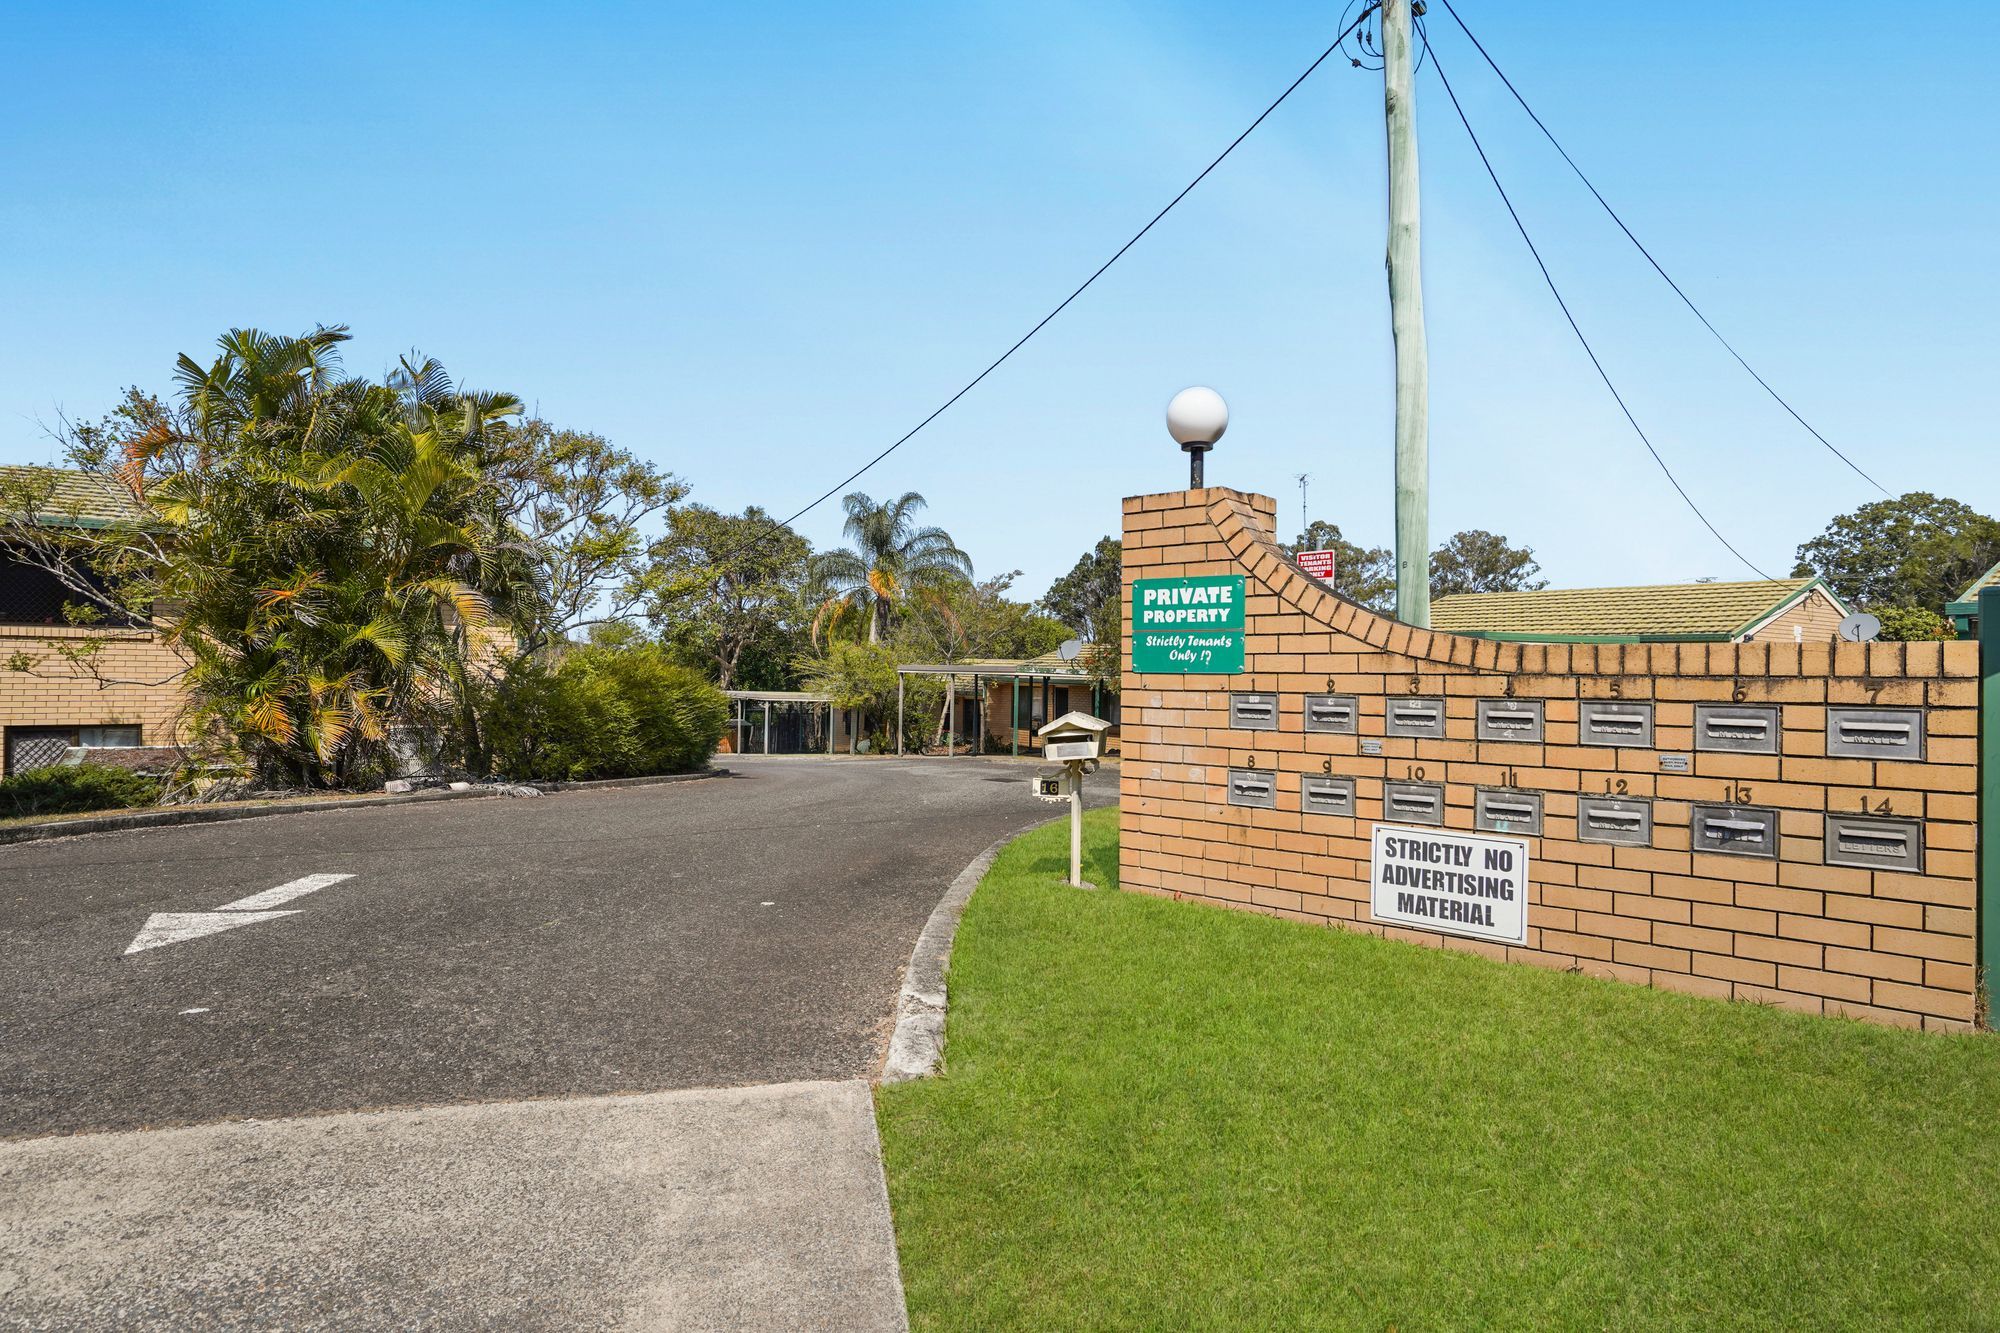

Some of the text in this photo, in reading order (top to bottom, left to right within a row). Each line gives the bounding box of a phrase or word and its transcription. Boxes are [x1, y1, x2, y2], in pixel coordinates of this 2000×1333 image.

[1300, 559, 1332, 567] TENANTS
[1143, 586, 1233, 605] PRIVATE
[1143, 608, 1230, 623] PROPERTY
[1146, 635, 1232, 648] Strictly Tenants
[1169, 649, 1197, 663] Only
[1251, 678, 1255, 691] 1
[1326, 679, 1335, 694] 2
[1409, 677, 1420, 695] 3
[1503, 680, 1516, 698] 4
[1609, 683, 1622, 699] 5
[1732, 685, 1747, 703] 6
[1865, 685, 1885, 704] 7
[1248, 755, 1255, 768] 8
[1323, 760, 1331, 773] 9
[1406, 765, 1425, 780] 10
[1501, 771, 1518, 788] 11
[1041, 783, 1058, 793] 16
[1605, 778, 1628, 795] 12
[1724, 785, 1752, 804] 13
[1860, 795, 1893, 815] 14
[1385, 837, 1513, 872] STRICTLY NO
[1845, 842, 1900, 854] LETTERS
[1382, 864, 1514, 901] ADVERTISING
[1397, 892, 1495, 927] MATERIAL
